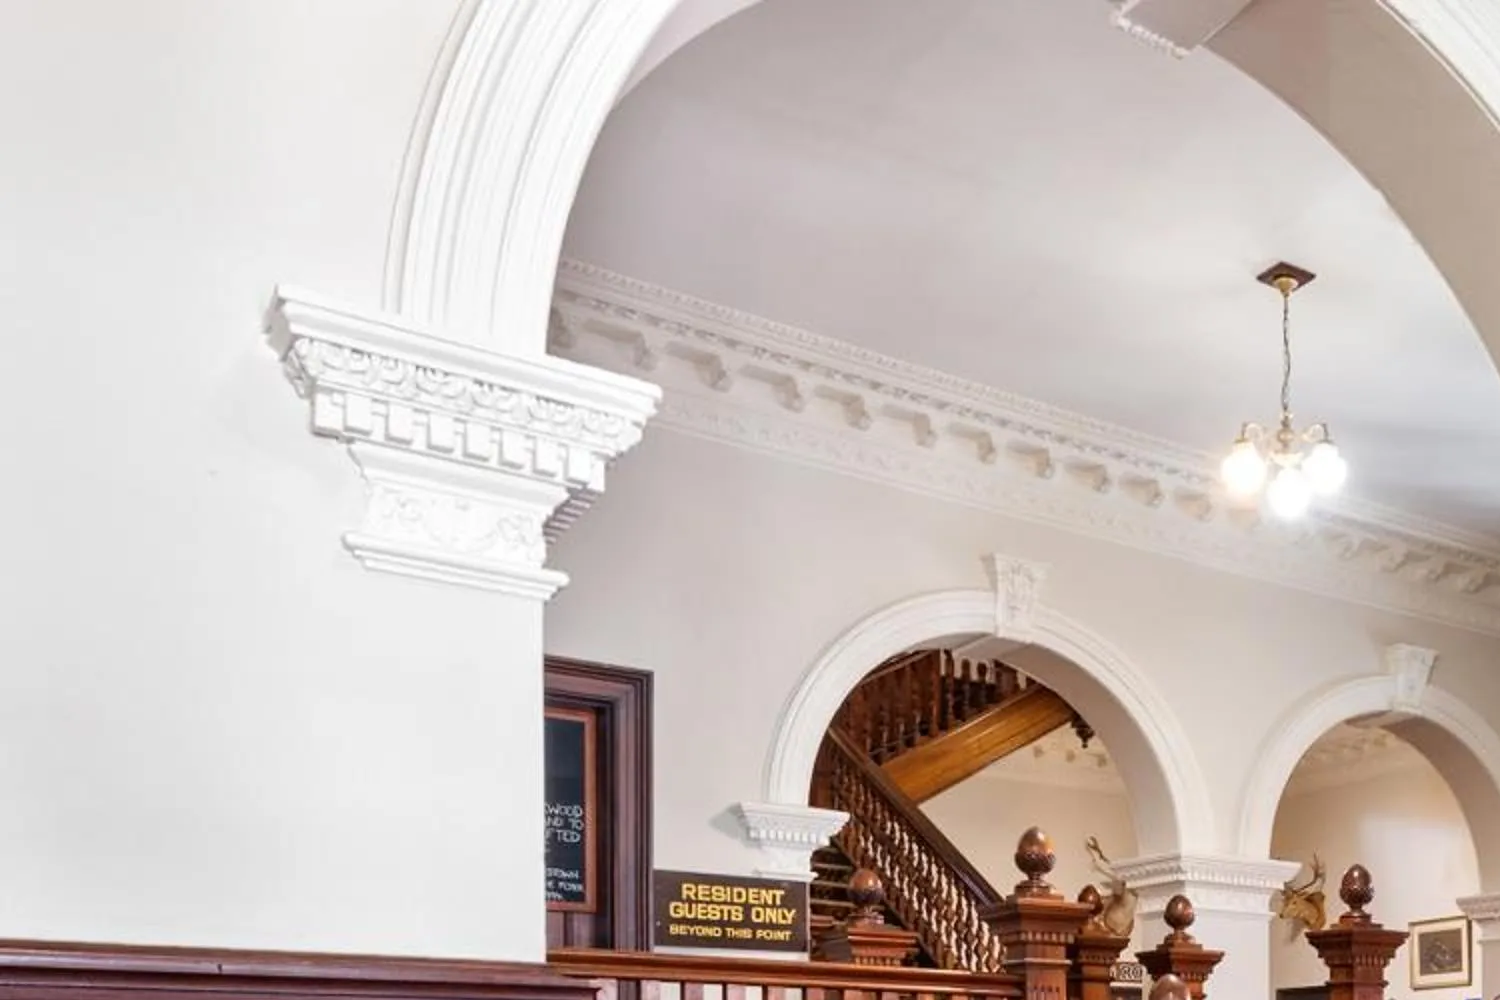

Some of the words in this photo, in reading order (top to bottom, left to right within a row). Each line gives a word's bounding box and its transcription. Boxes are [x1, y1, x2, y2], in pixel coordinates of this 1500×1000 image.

[681, 883, 785, 906] RESIDENT
[669, 901, 743, 922] GUESTS
[751, 906, 796, 925] ONLY
[669, 924, 722, 938] BEYOND
[725, 927, 753, 939] THIS
[756, 929, 792, 941] POINT
